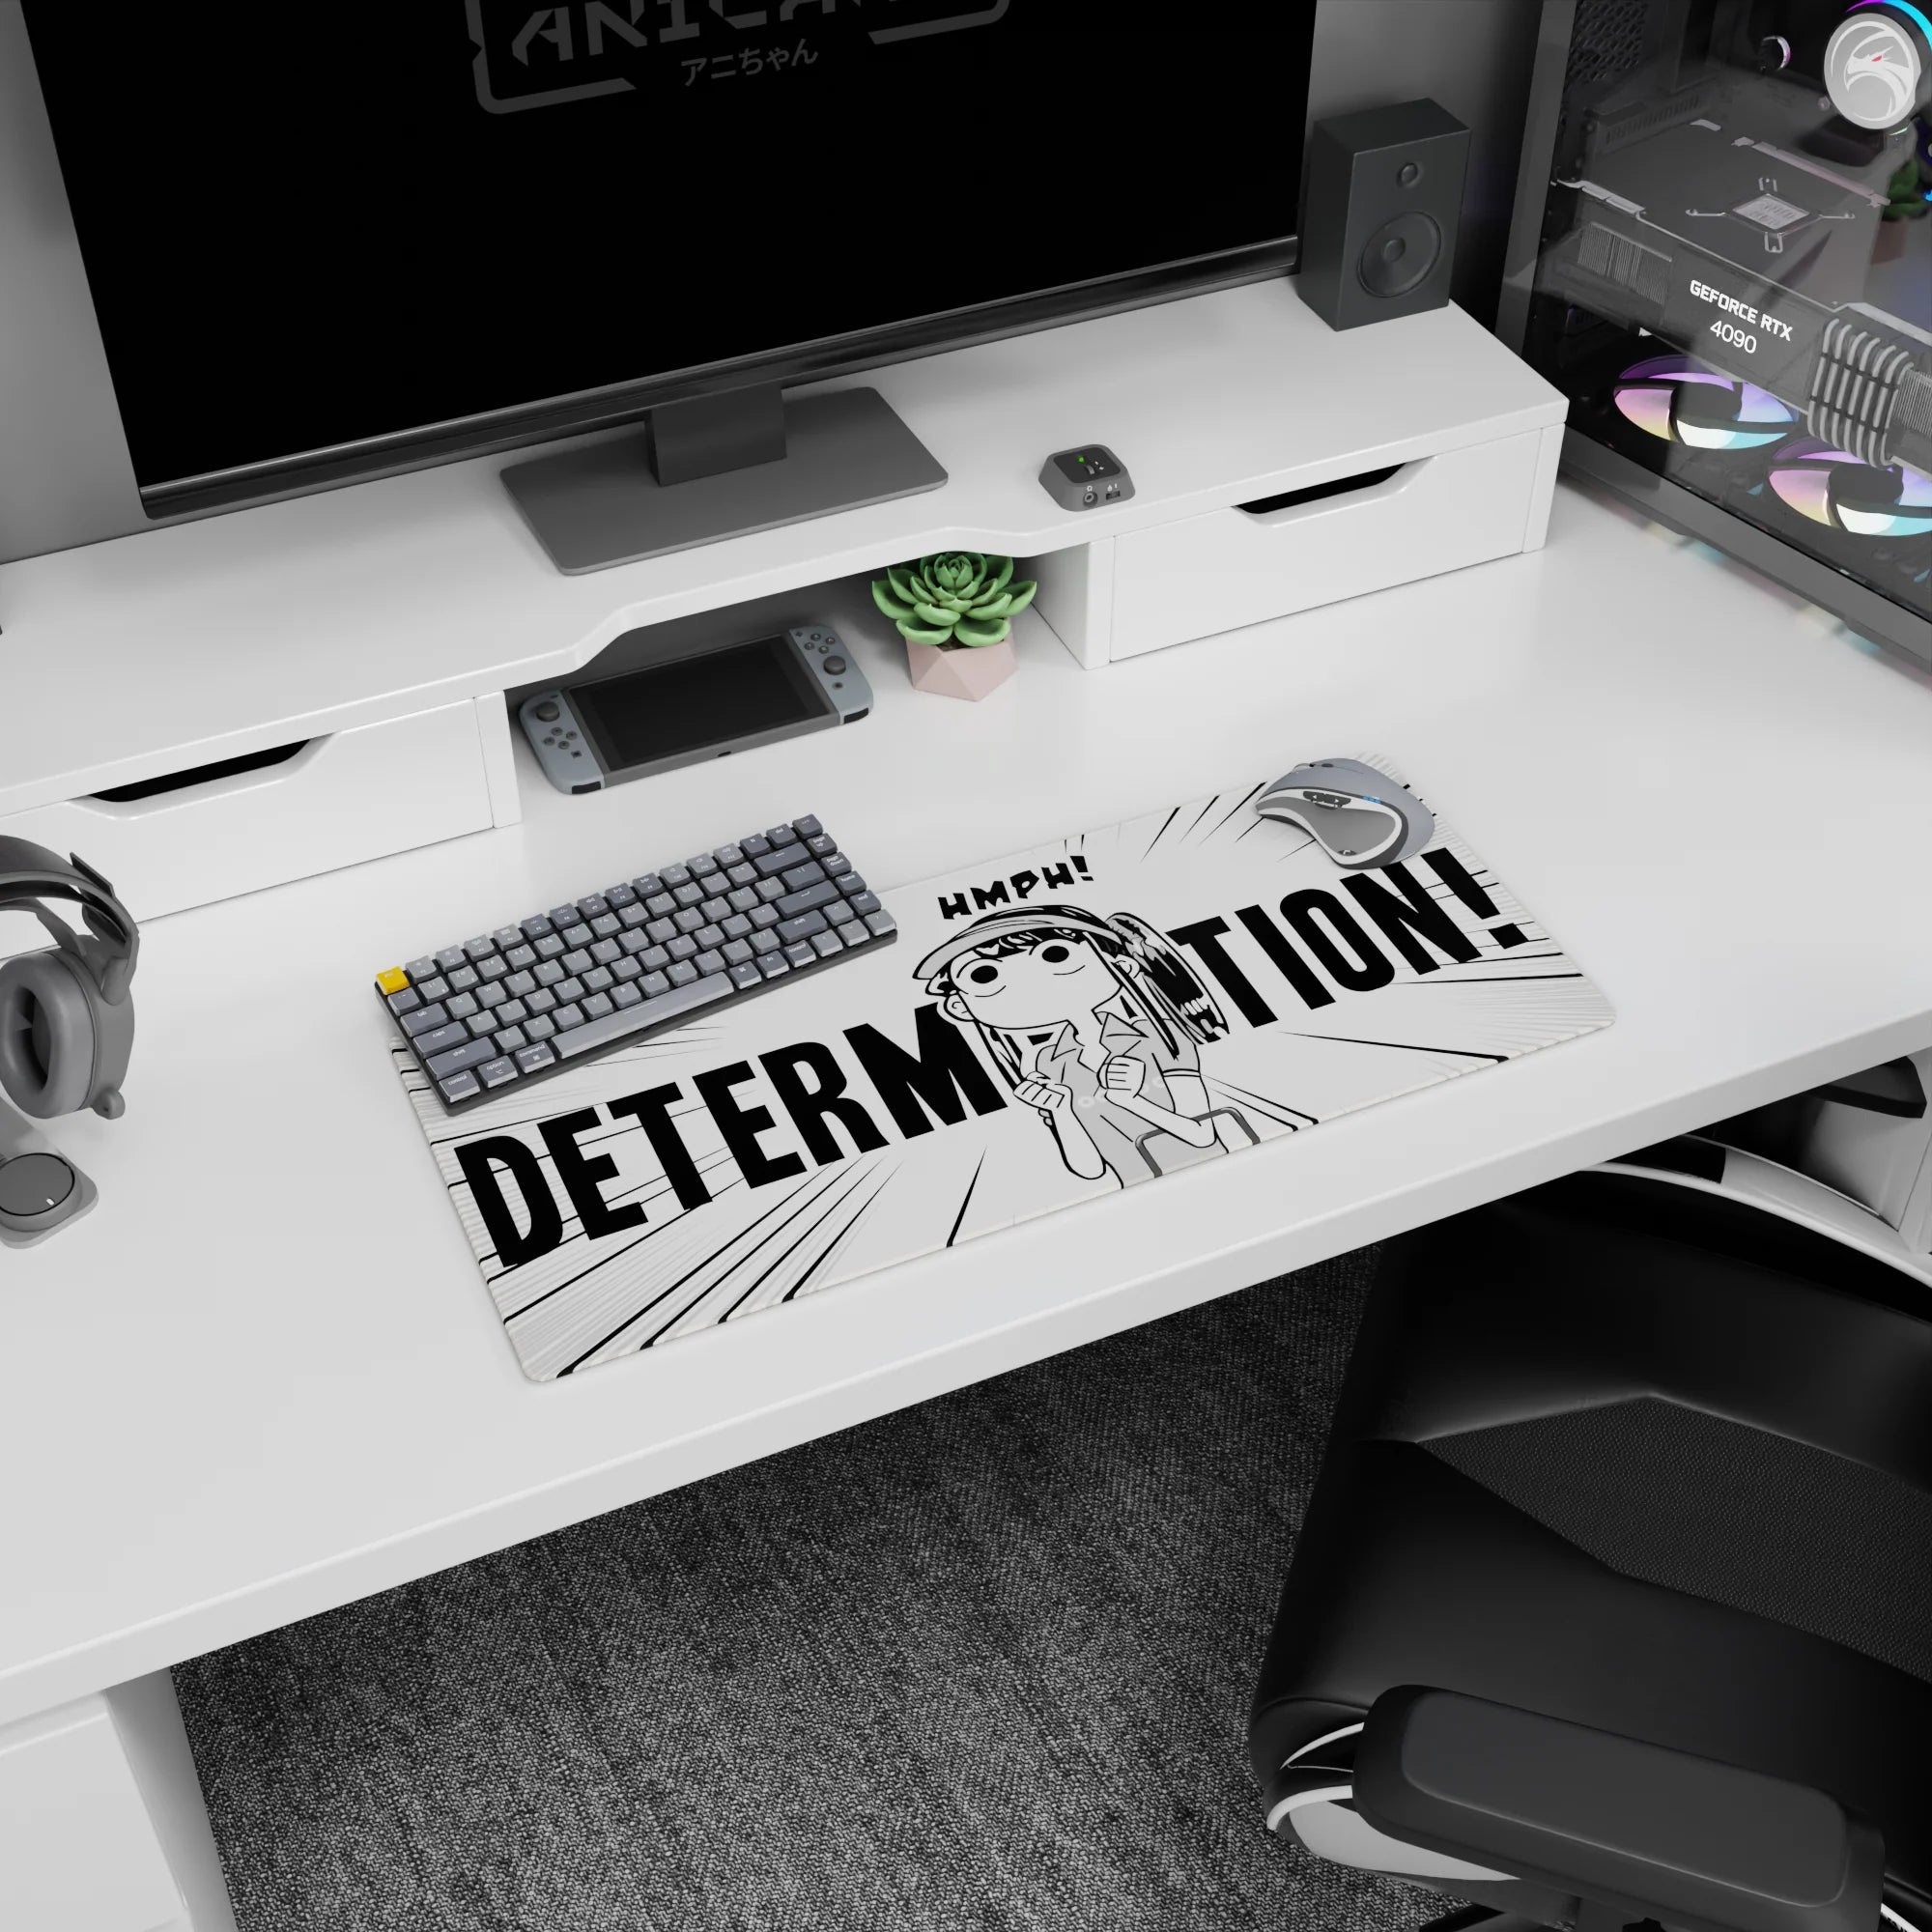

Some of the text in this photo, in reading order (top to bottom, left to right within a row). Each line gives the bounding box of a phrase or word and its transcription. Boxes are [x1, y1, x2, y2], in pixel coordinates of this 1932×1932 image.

[680, 39, 818, 86] アニちゃん
[1690, 280, 1793, 341] GEFORCE RTX
[1710, 321, 1757, 354] 4090
[938, 856, 1094, 920] HMPH!
[447, 1075, 468, 1086] control
[486, 1061, 505, 1071] option
